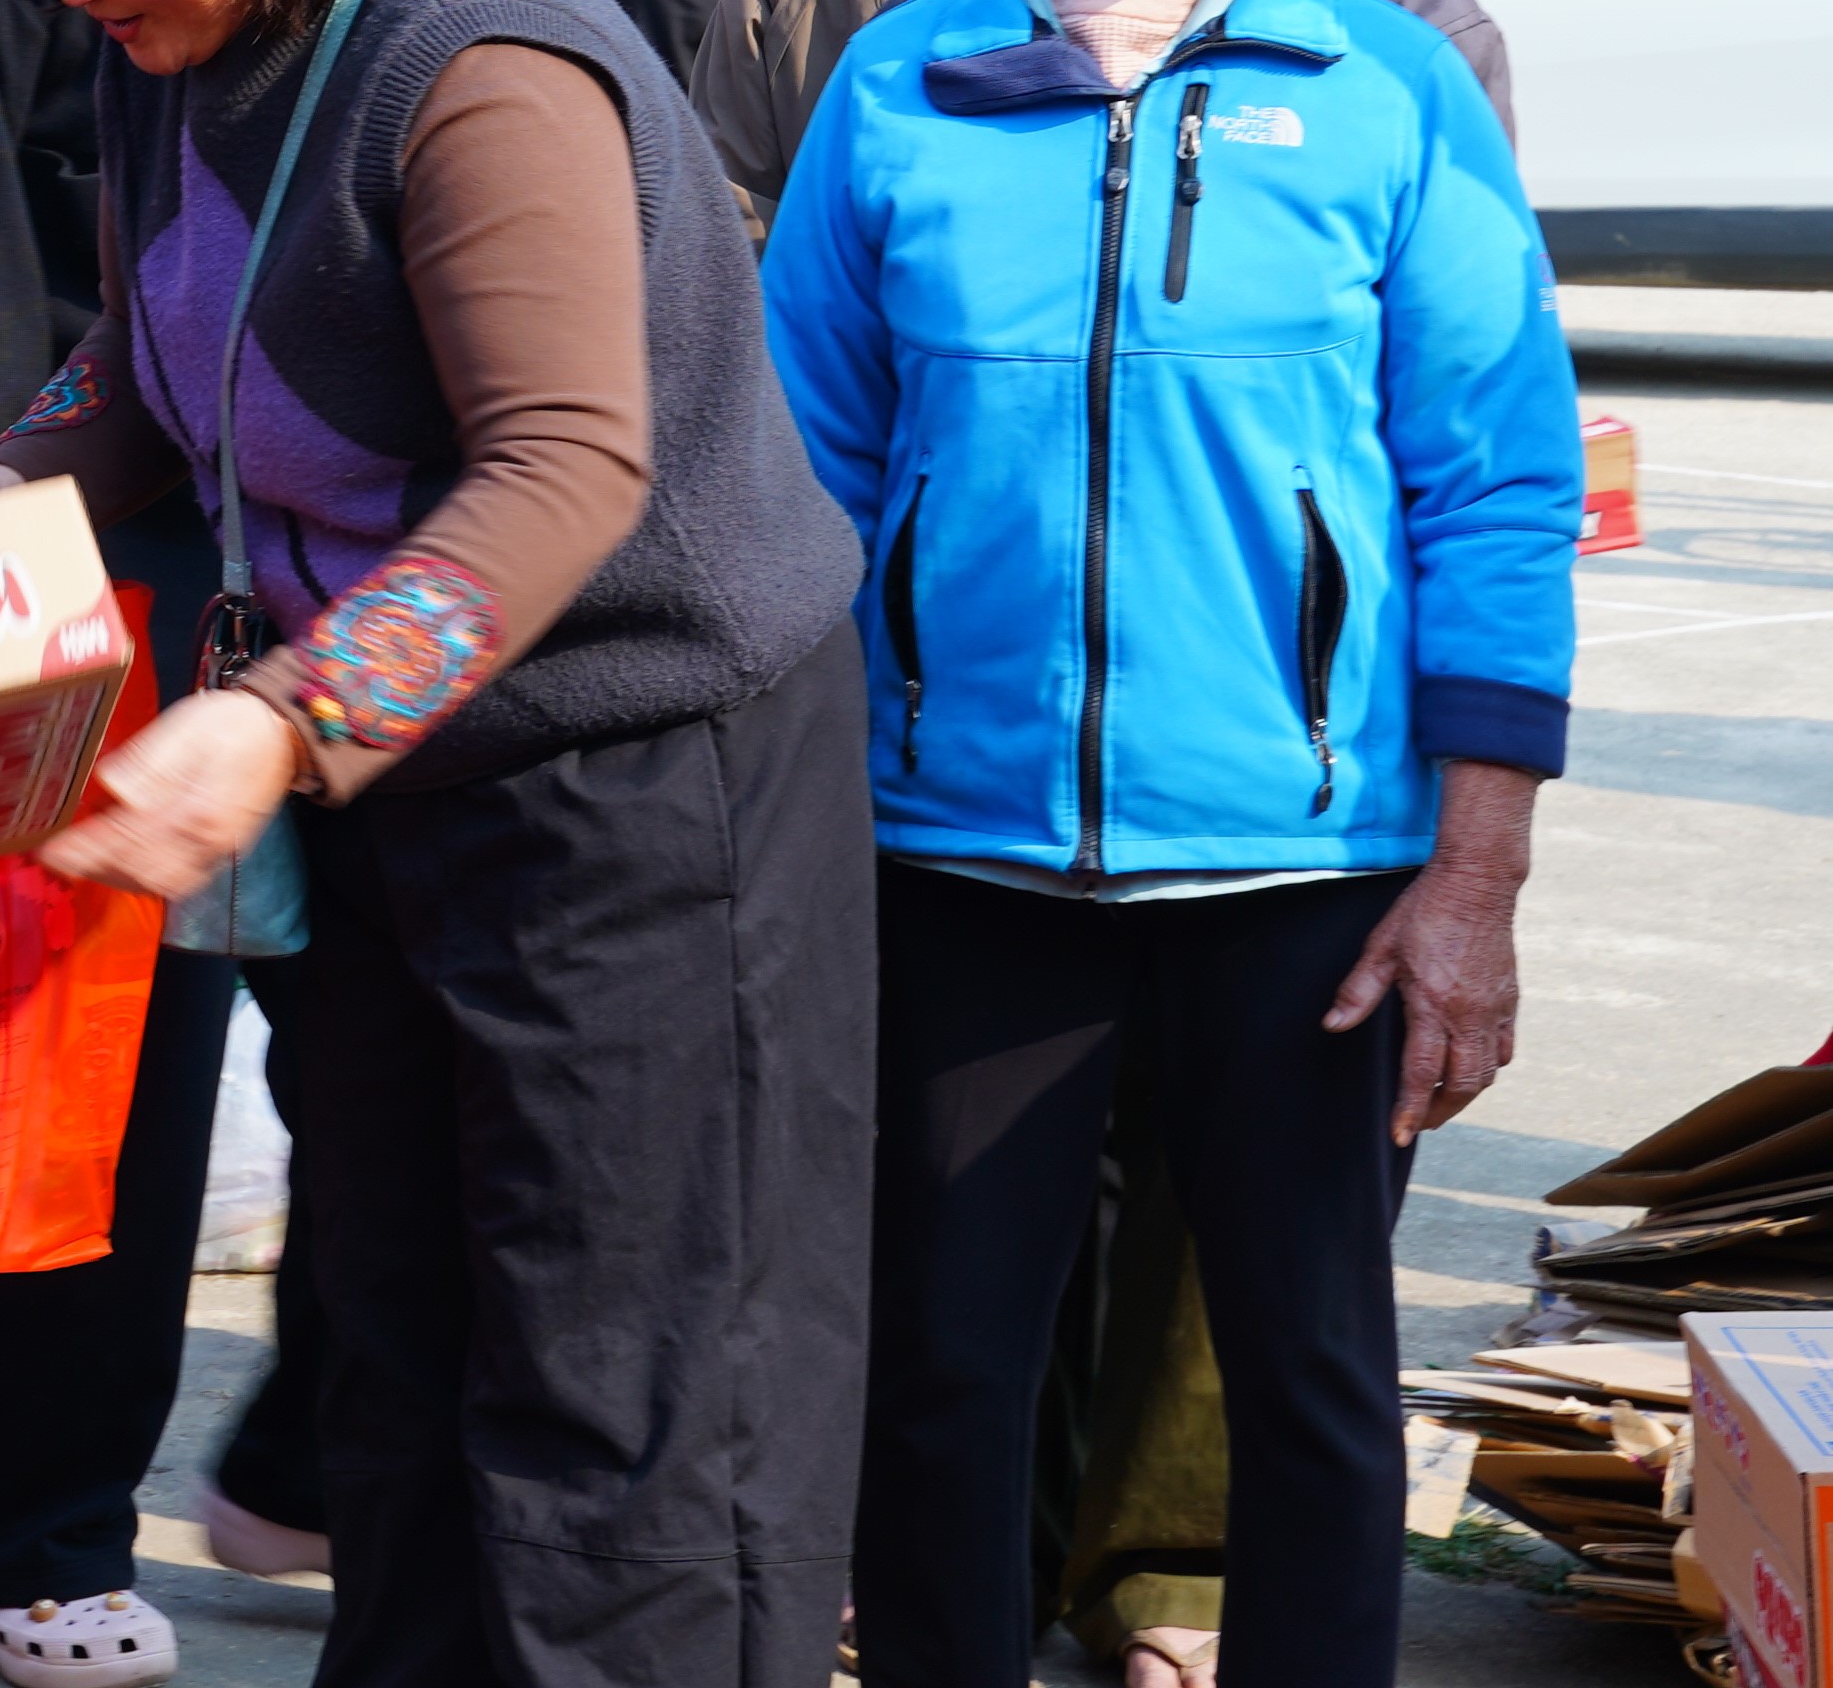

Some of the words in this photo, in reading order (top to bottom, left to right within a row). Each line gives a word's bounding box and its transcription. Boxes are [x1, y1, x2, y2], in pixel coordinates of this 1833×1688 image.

[1237, 105, 1273, 119] THE
[1207, 115, 1273, 131] NORTH
[1222, 130, 1272, 144] FACE
